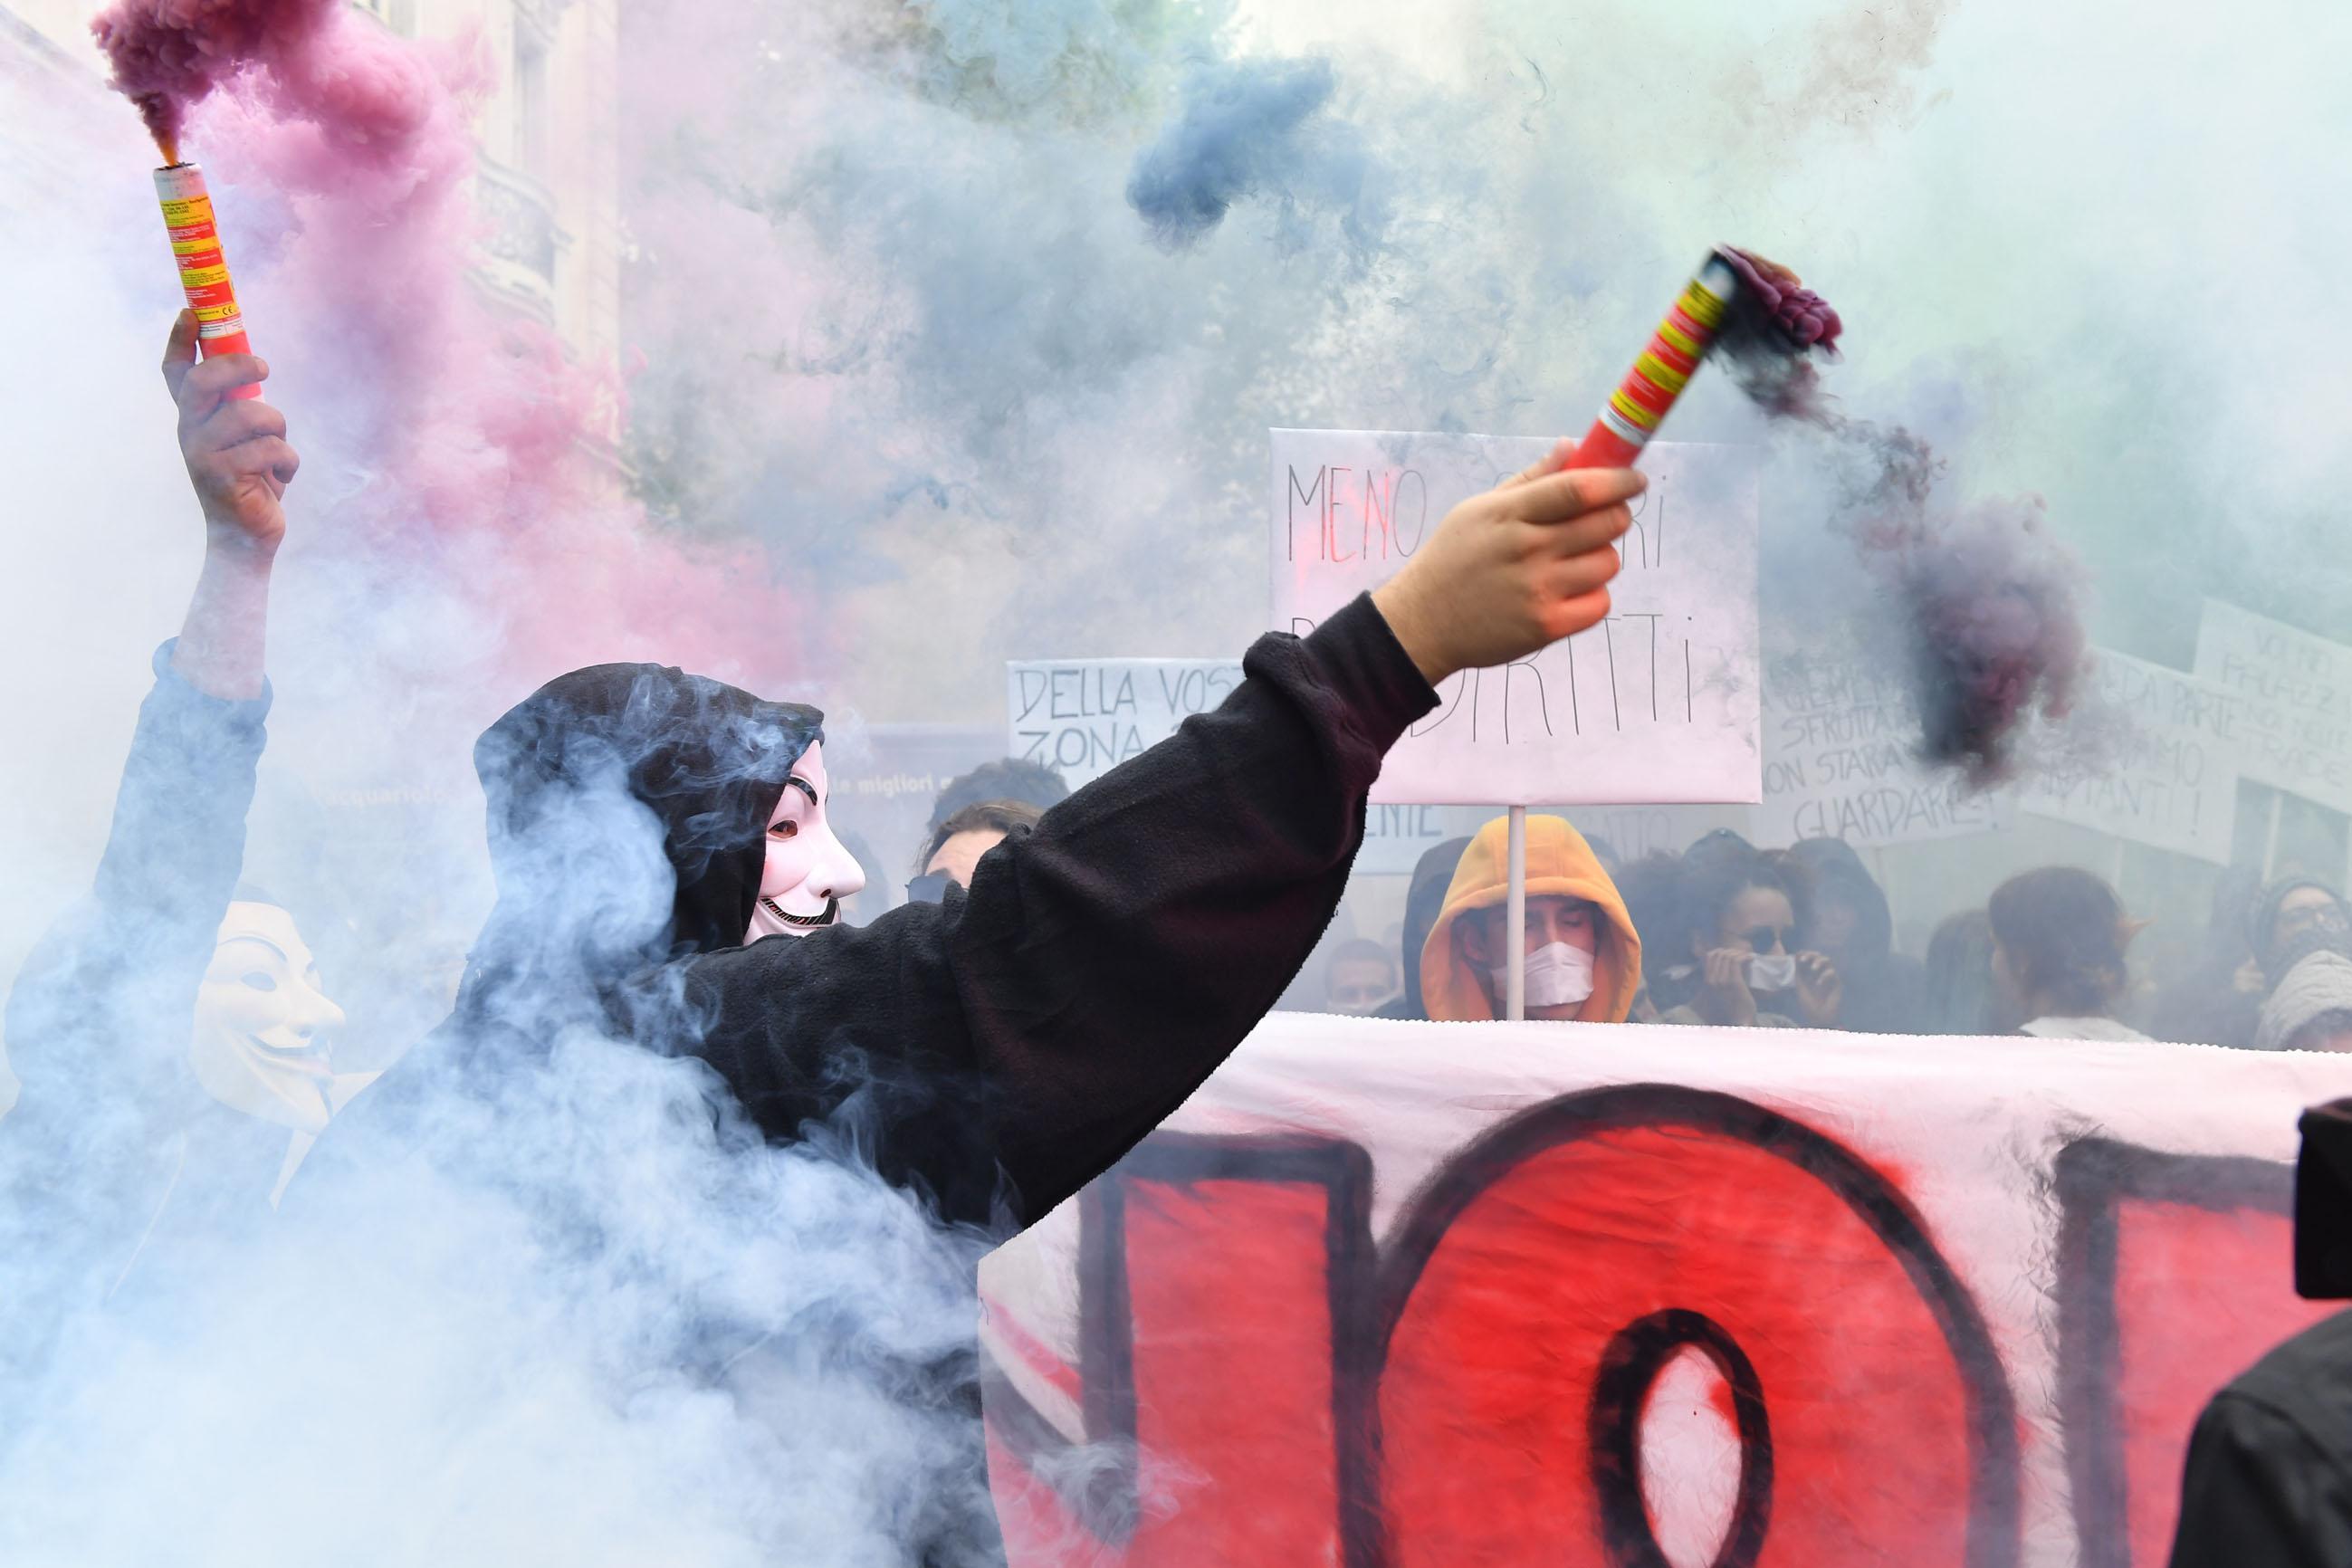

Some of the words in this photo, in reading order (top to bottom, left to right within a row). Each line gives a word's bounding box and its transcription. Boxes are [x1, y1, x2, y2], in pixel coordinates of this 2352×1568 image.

[1287, 463, 1428, 563] MENO
[1015, 668, 1138, 722] DELLA
[1018, 722, 1146, 770] ZONA
[857, 771, 934, 799] migliori
